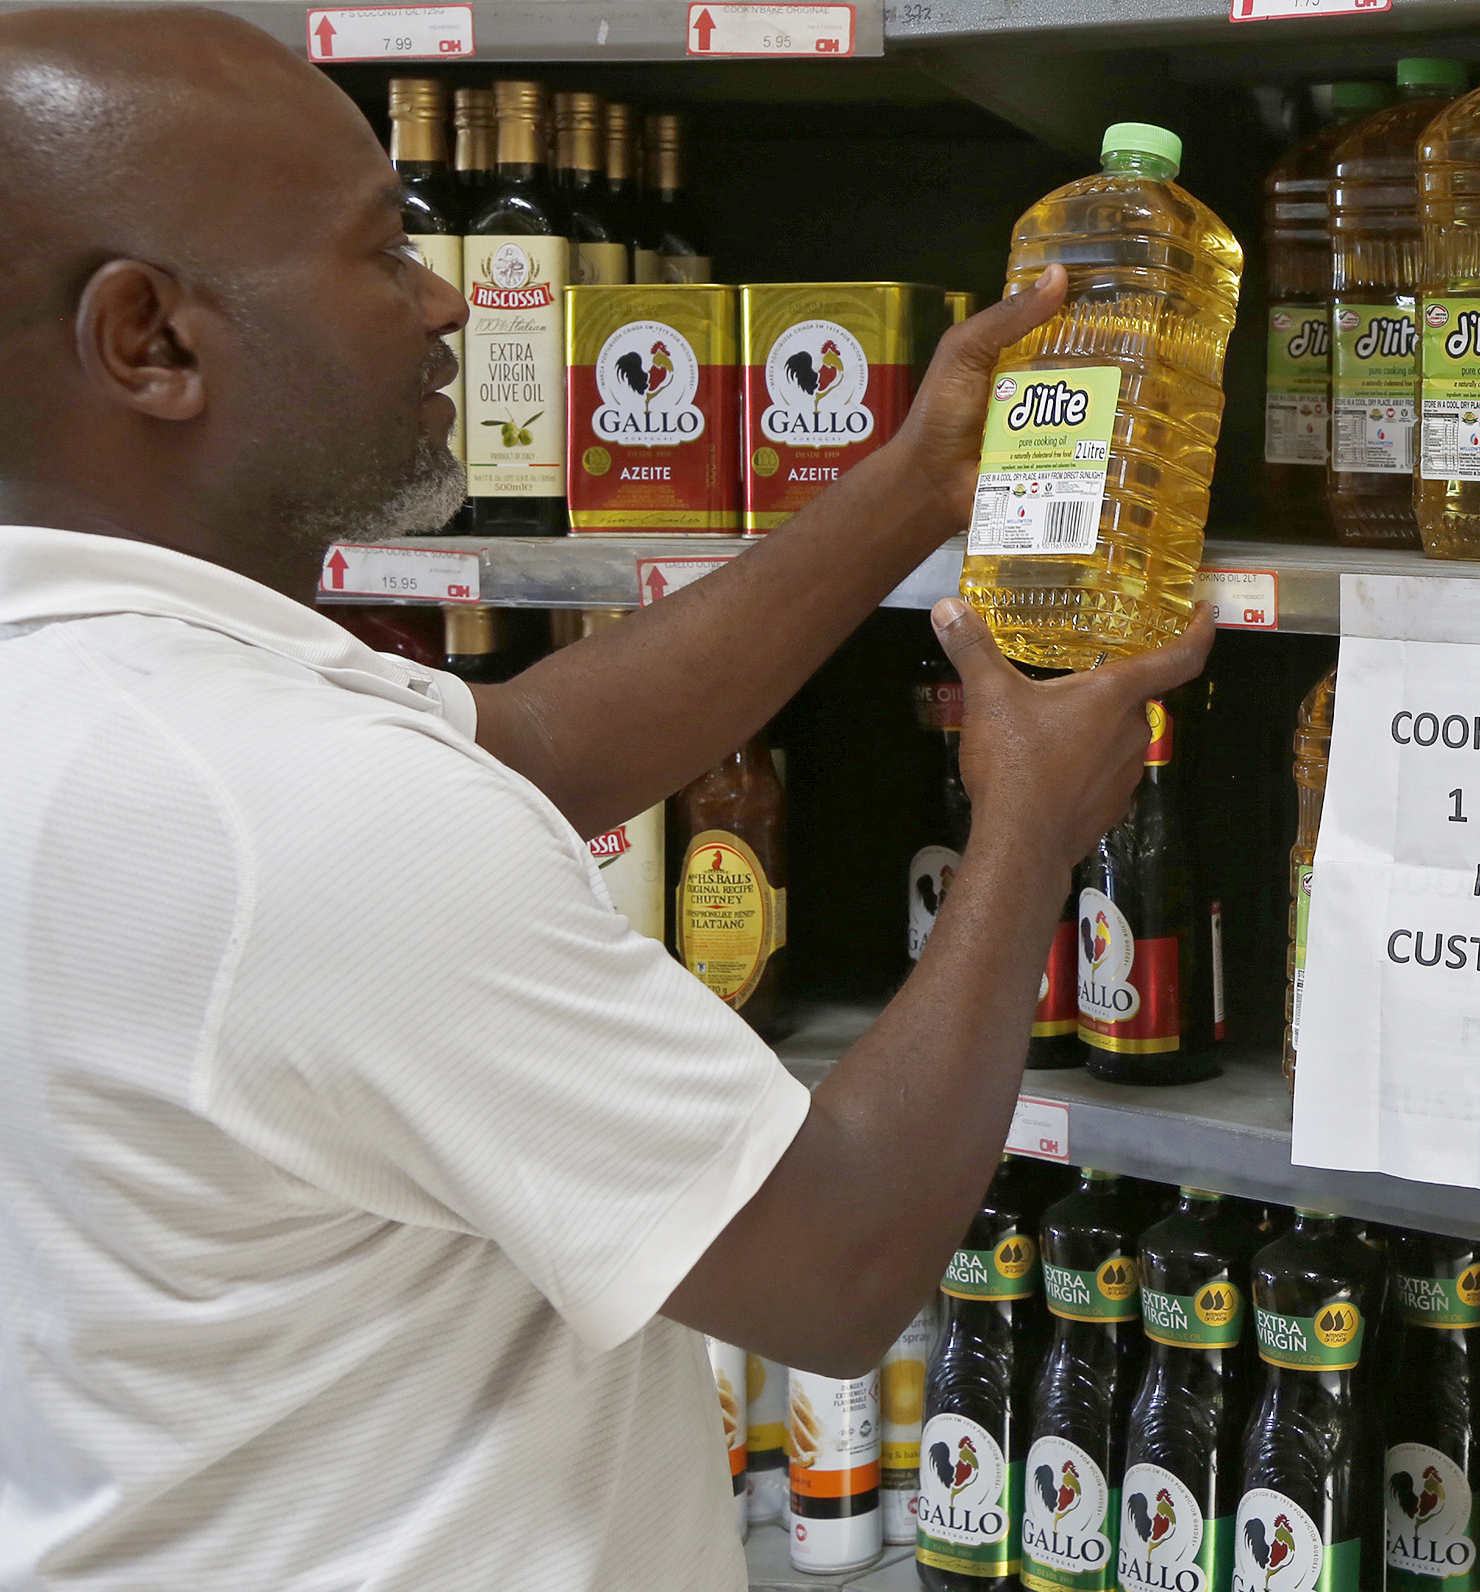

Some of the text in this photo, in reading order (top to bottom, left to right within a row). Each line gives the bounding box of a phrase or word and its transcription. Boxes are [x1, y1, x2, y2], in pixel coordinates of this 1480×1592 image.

[383, 38, 412, 50] 7.99
[763, 36, 791, 48] 5.95
[477, 288, 546, 307] RISCOSSA
[490, 343, 533, 362] EXTRA
[488, 363, 535, 382] VIRGIN
[480, 384, 545, 402] OLIVE OIL
[1008, 381, 1088, 430] d'lite
[600, 410, 698, 434] GALLO
[768, 411, 868, 434] GALLO
[1019, 435, 1067, 448] pure cooking oil
[1075, 442, 1105, 459] 2 Litre
[620, 466, 671, 480] AZEITE
[788, 468, 839, 481] AZEITE
[382, 576, 417, 589] 15.95
[1200, 573, 1257, 582] OKING OIL 2LT
[1448, 787, 1468, 824] 1
[692, 895, 743, 904] CHUTNEY
[1045, 1264, 1086, 1290] EXTRA
[1046, 1282, 1091, 1305] VIRGIN
[1141, 1288, 1184, 1314] EXTRA
[1142, 1303, 1188, 1330] VIRGIN
[1257, 1310, 1303, 1336] EXTRA
[1258, 1324, 1308, 1352] VIRGIN
[917, 1495, 1003, 1536] GALLO
[1023, 1518, 1105, 1563] GALLO
[1118, 1549, 1199, 1592] GALLO
